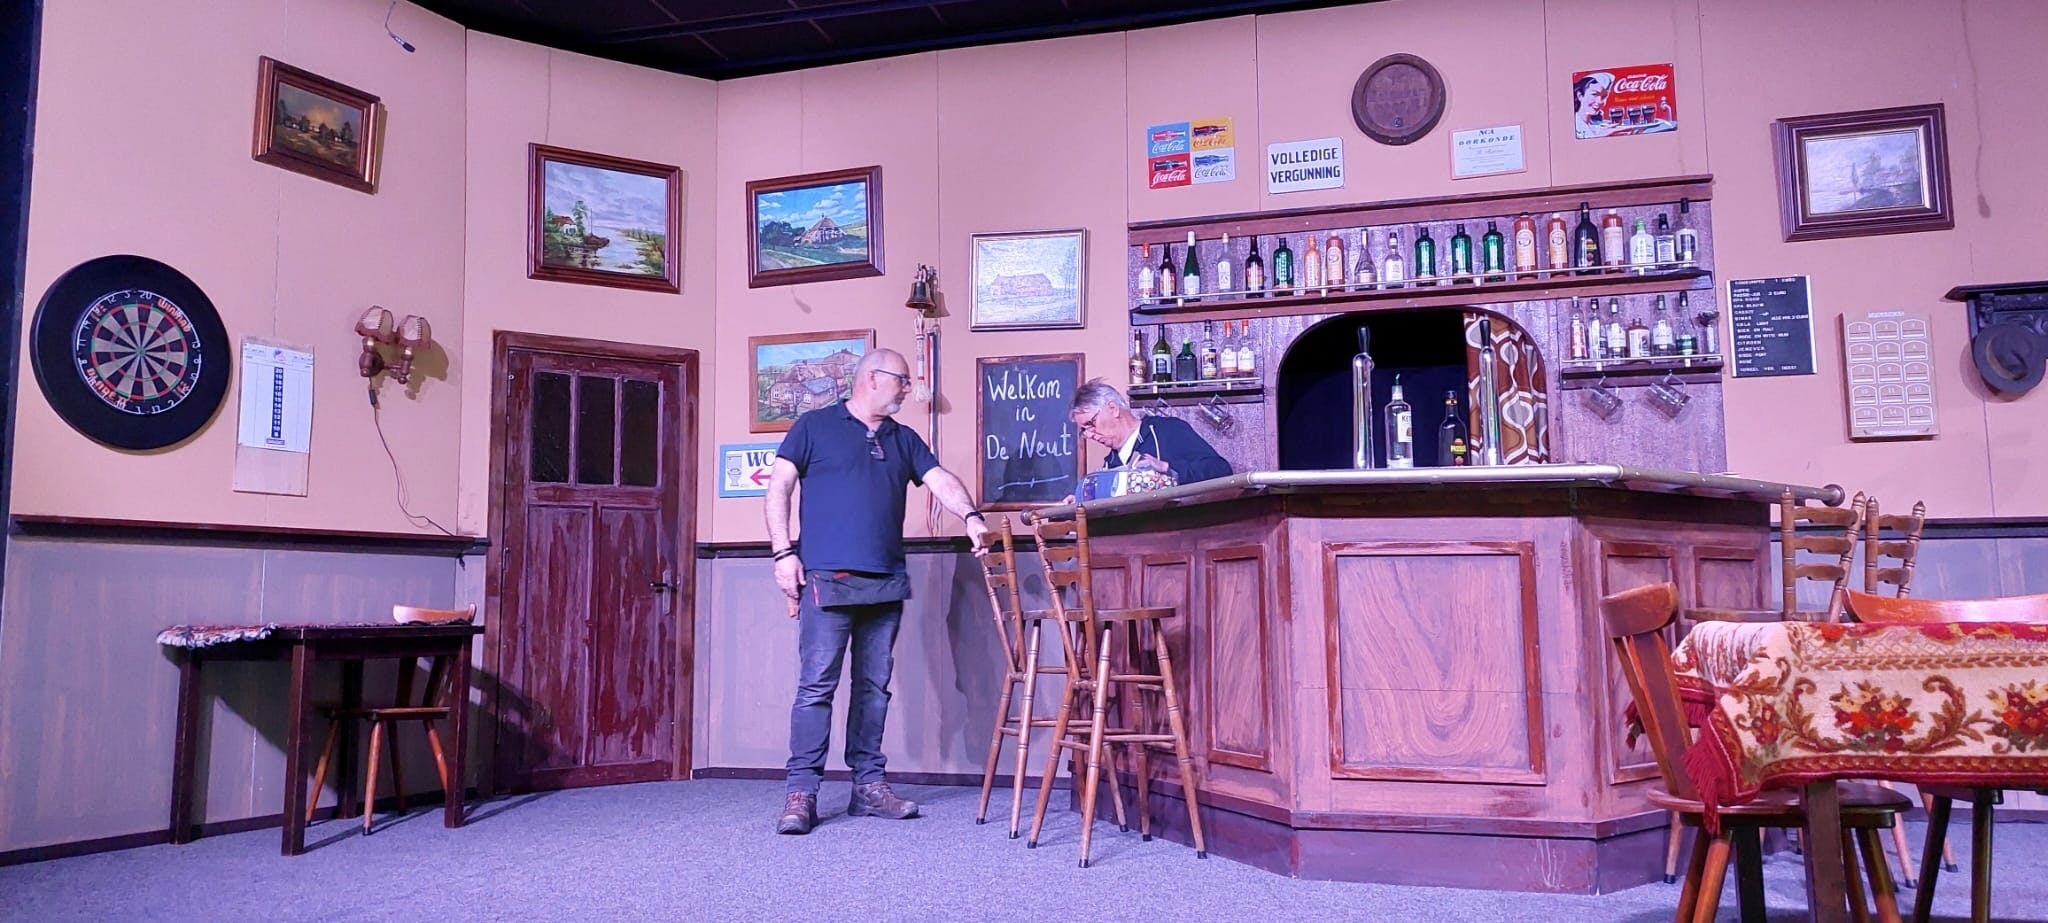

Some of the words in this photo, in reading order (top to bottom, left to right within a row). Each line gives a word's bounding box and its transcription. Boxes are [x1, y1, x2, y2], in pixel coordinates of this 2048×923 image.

[1614, 74, 1669, 94] Coca-Cola
[1271, 148, 1339, 165] VOLLEDIGE
[1270, 166, 1341, 184] VERGUNNING
[1016, 404, 1036, 422] in
[986, 434, 1010, 460] De
[1020, 422, 1072, 459] Neut
[746, 451, 775, 467] WC
